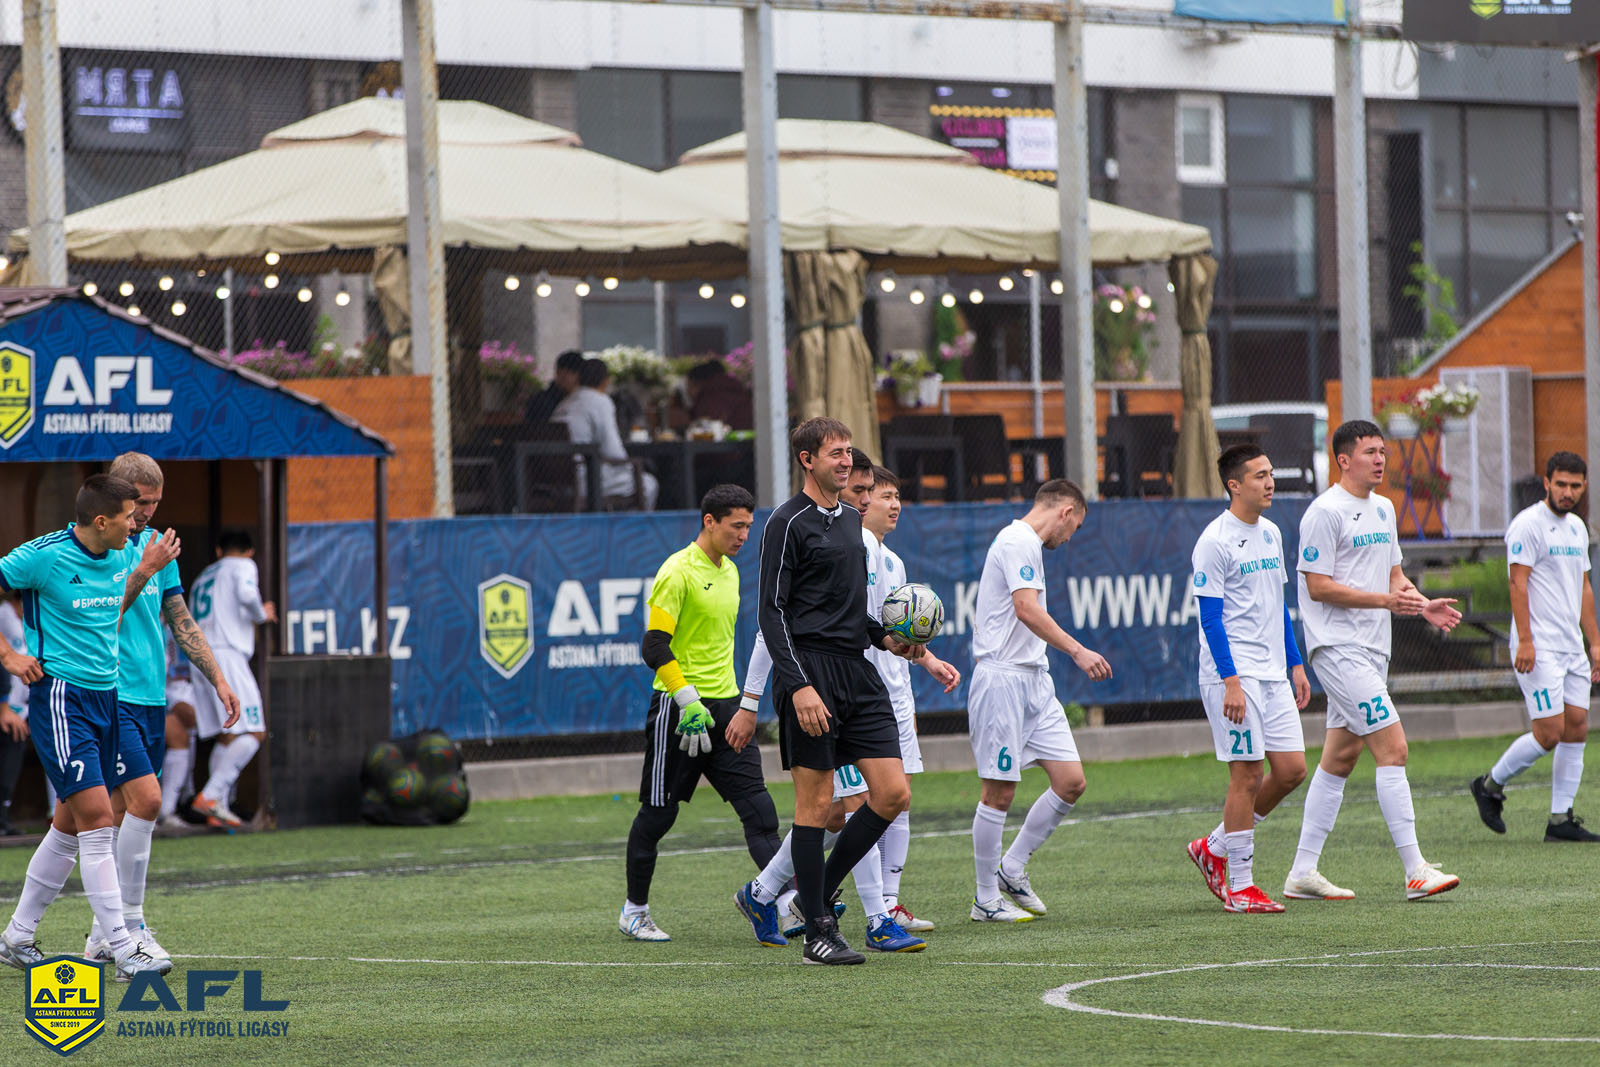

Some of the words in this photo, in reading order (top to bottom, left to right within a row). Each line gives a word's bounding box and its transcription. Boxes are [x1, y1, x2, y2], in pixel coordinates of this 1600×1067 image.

[75, 66, 184, 107] МЯТА
[0, 378, 26, 392] FL
[43, 356, 174, 406] AFL
[43, 413, 89, 434] ASTANA
[132, 413, 173, 434] LIGASY
[547, 644, 597, 669] ASTANA
[1358, 696, 1390, 726] 23
[1532, 688, 1552, 712] 11
[1229, 729, 1254, 755] 21
[70, 759, 85, 782] 7
[997, 746, 1012, 772] 6
[837, 763, 863, 788] 10
